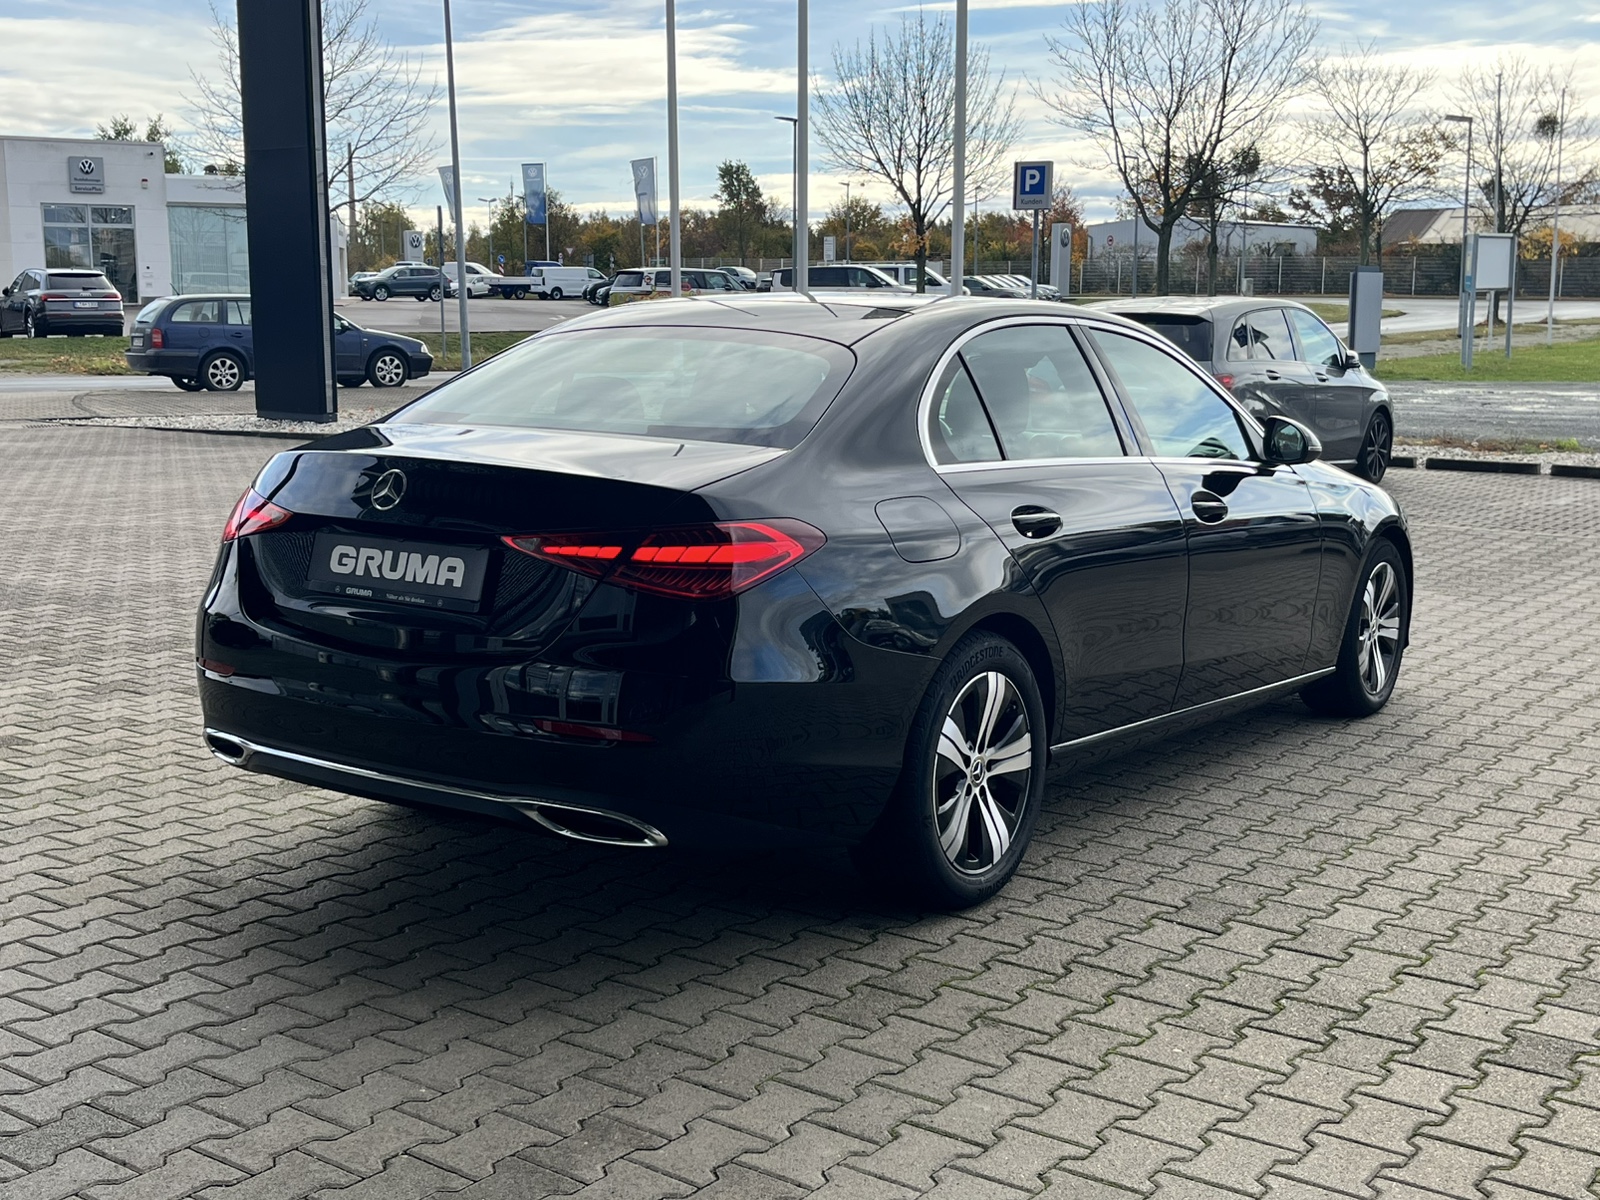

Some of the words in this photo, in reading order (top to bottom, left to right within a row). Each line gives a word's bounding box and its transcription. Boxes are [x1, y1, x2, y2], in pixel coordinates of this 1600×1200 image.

[1025, 169, 1040, 192] P
[329, 545, 465, 587] GRUMA
[345, 587, 373, 597] GRUMA
[949, 645, 1004, 692] BRIDGESTONE
